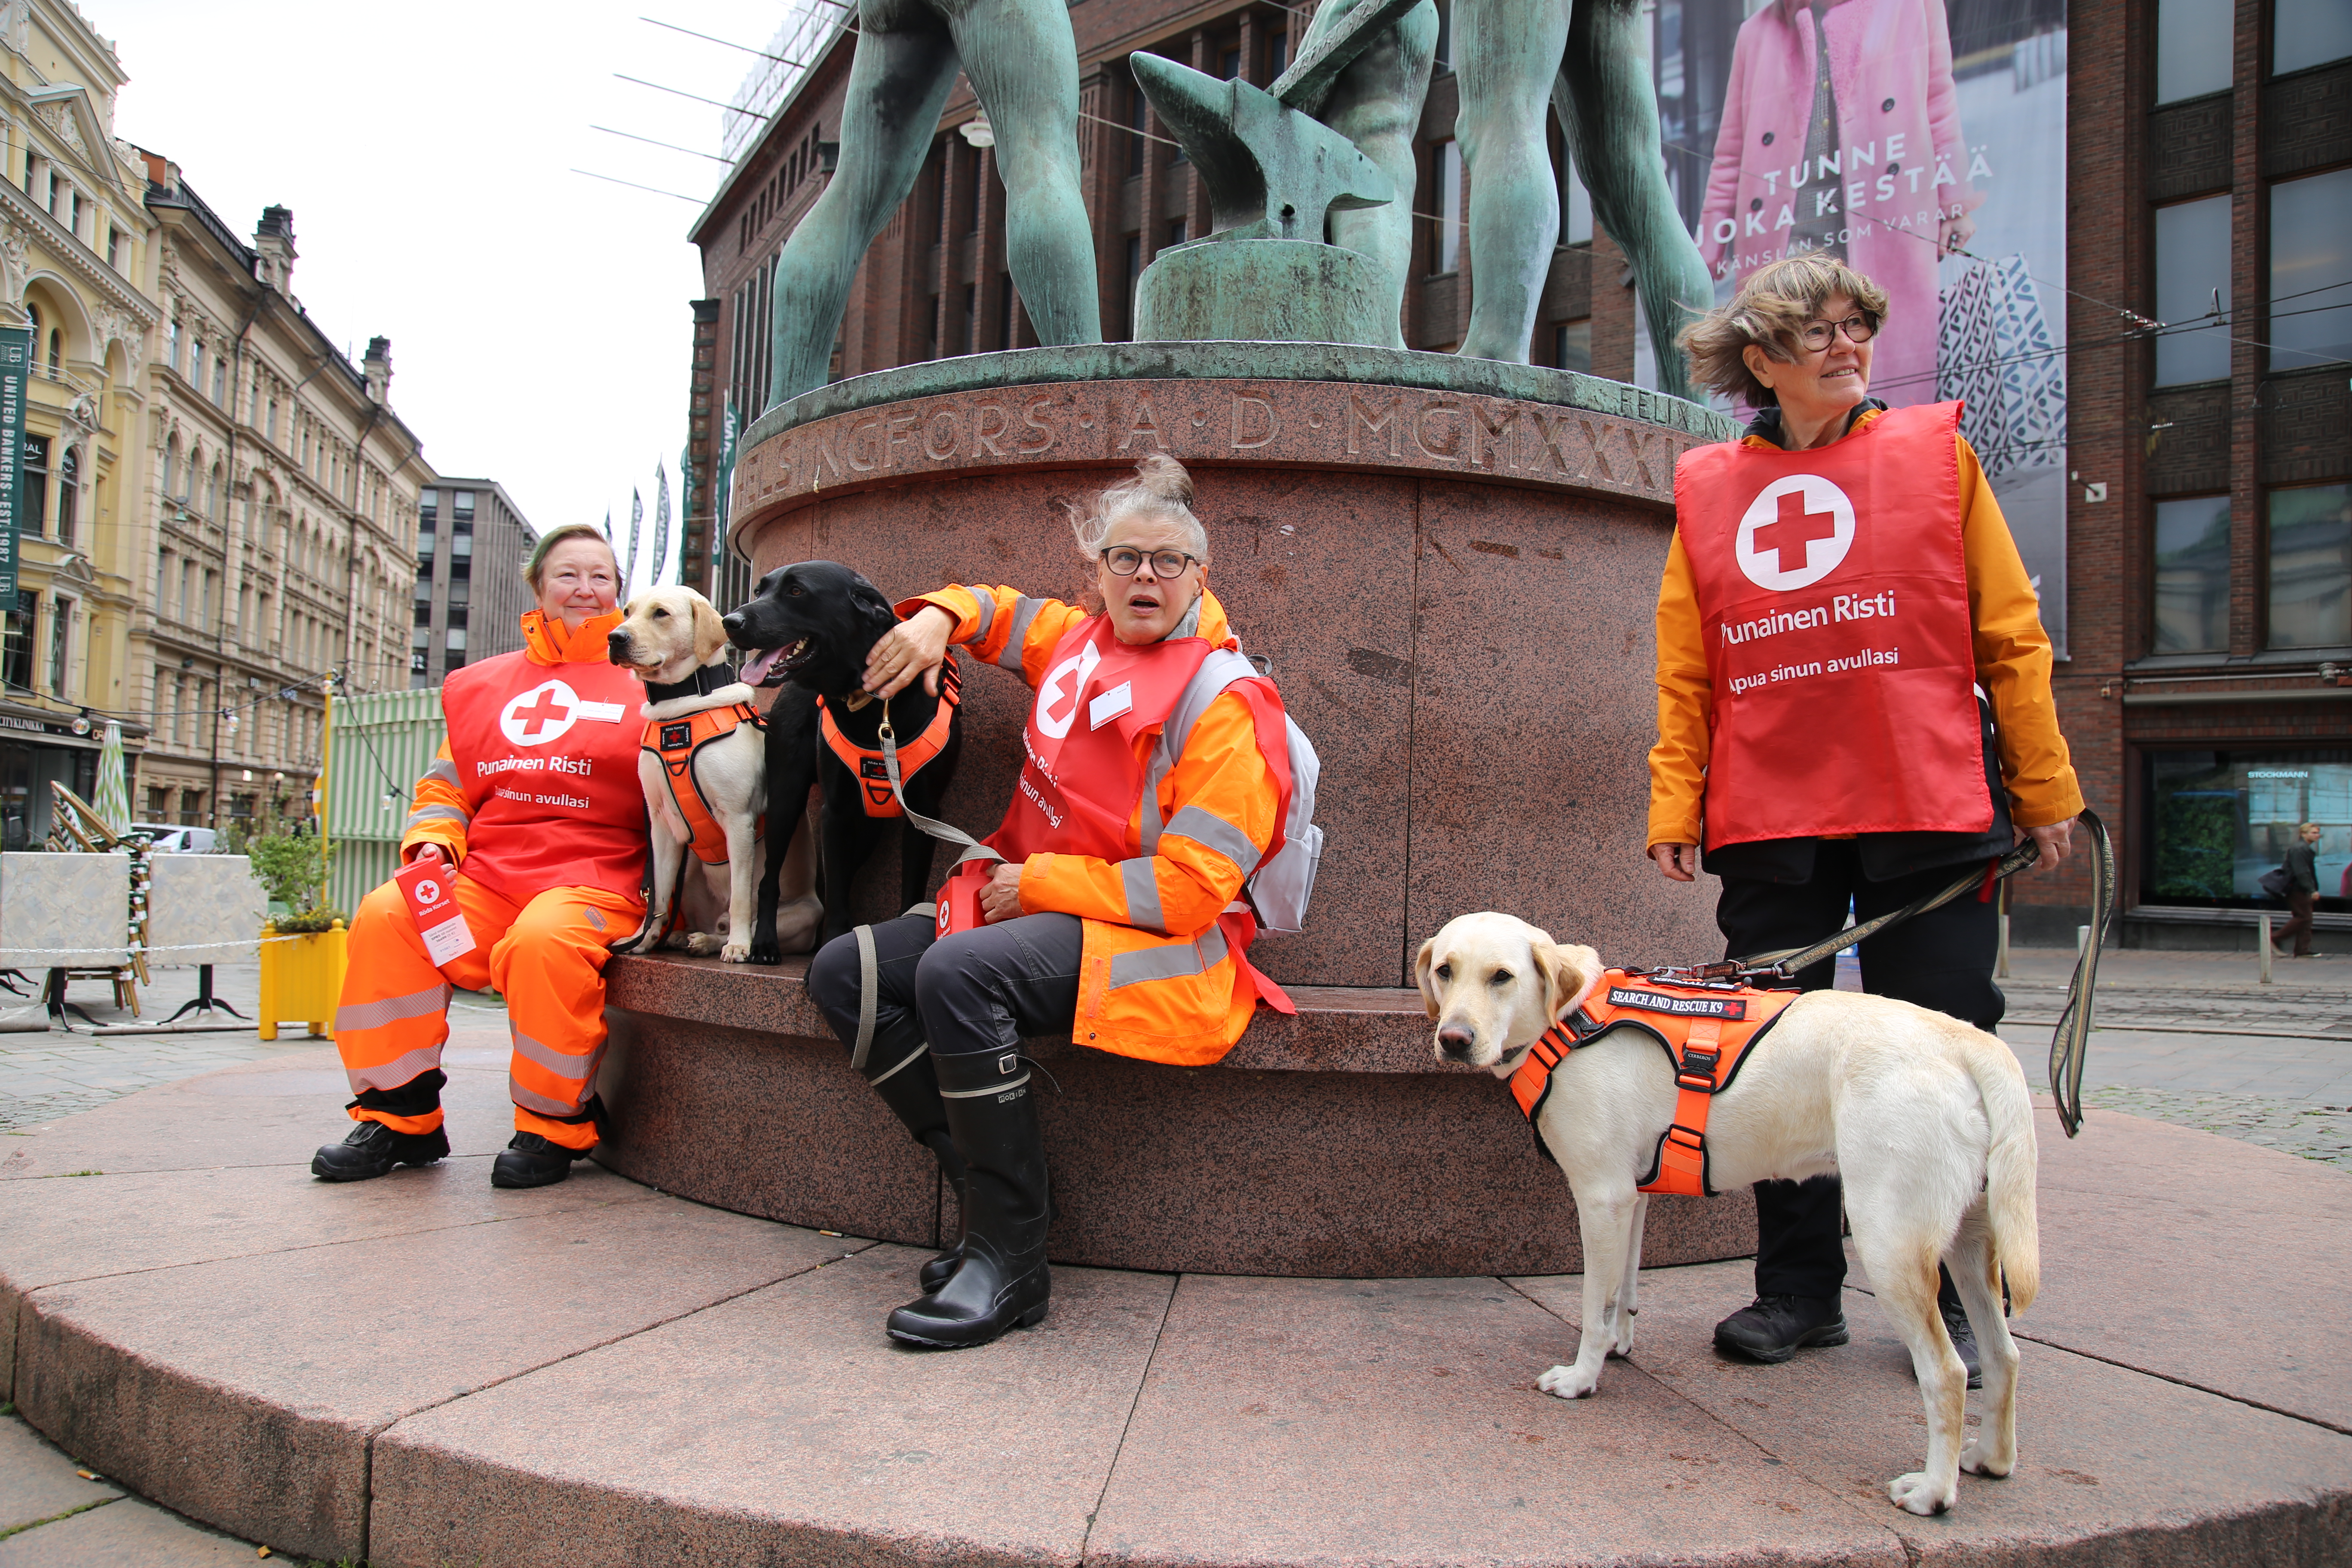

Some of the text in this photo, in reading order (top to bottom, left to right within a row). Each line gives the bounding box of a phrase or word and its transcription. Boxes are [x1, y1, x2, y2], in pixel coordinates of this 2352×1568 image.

[1764, 132, 1906, 196] TUNNE
[1696, 144, 1993, 248] JOKA KESTÄÄ
[1824, 224, 1872, 248] SOM
[1883, 202, 1965, 232] VARAR
[3, 375, 18, 424] UNITED
[1118, 389, 1170, 450] A
[1231, 389, 1281, 450] D
[1620, 387, 1688, 430] FELIX
[0, 429, 15, 490] BANKERS
[0, 532, 11, 563] 1987
[1721, 589, 1896, 648] Punainen Risti
[1770, 661, 1822, 682] sinun
[1827, 647, 1899, 673] avullasi
[477, 754, 592, 778] Punainen Risti
[503, 787, 532, 802] sinun
[536, 794, 590, 809] avullasi
[419, 898, 451, 917] Röda Korset
[1611, 990, 1724, 1014] SEARCH AND RESCUE K9
